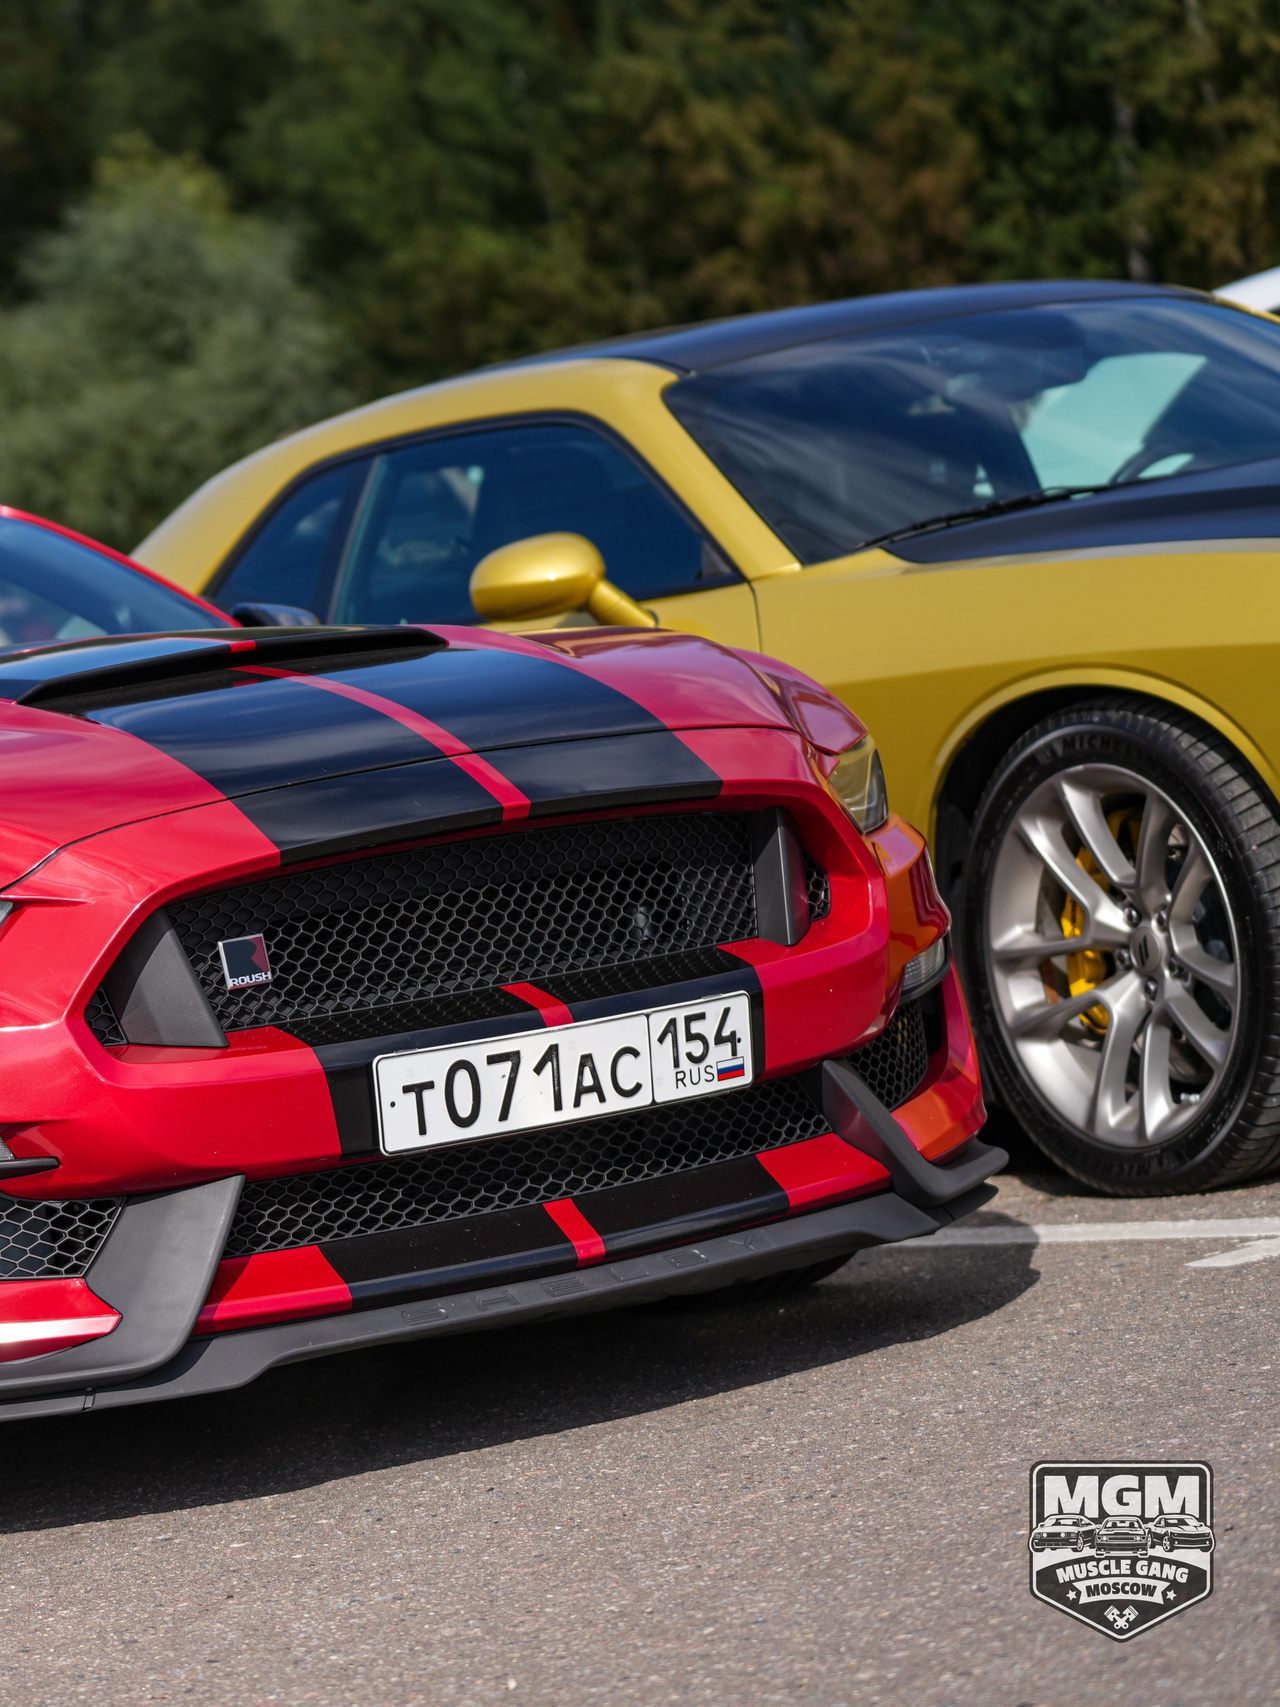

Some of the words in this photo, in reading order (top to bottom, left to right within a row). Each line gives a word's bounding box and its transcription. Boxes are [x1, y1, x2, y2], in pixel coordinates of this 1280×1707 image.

[230, 972, 271, 986] ROUSH
[657, 1006, 738, 1068] 154
[675, 1064, 715, 1089] RUS
